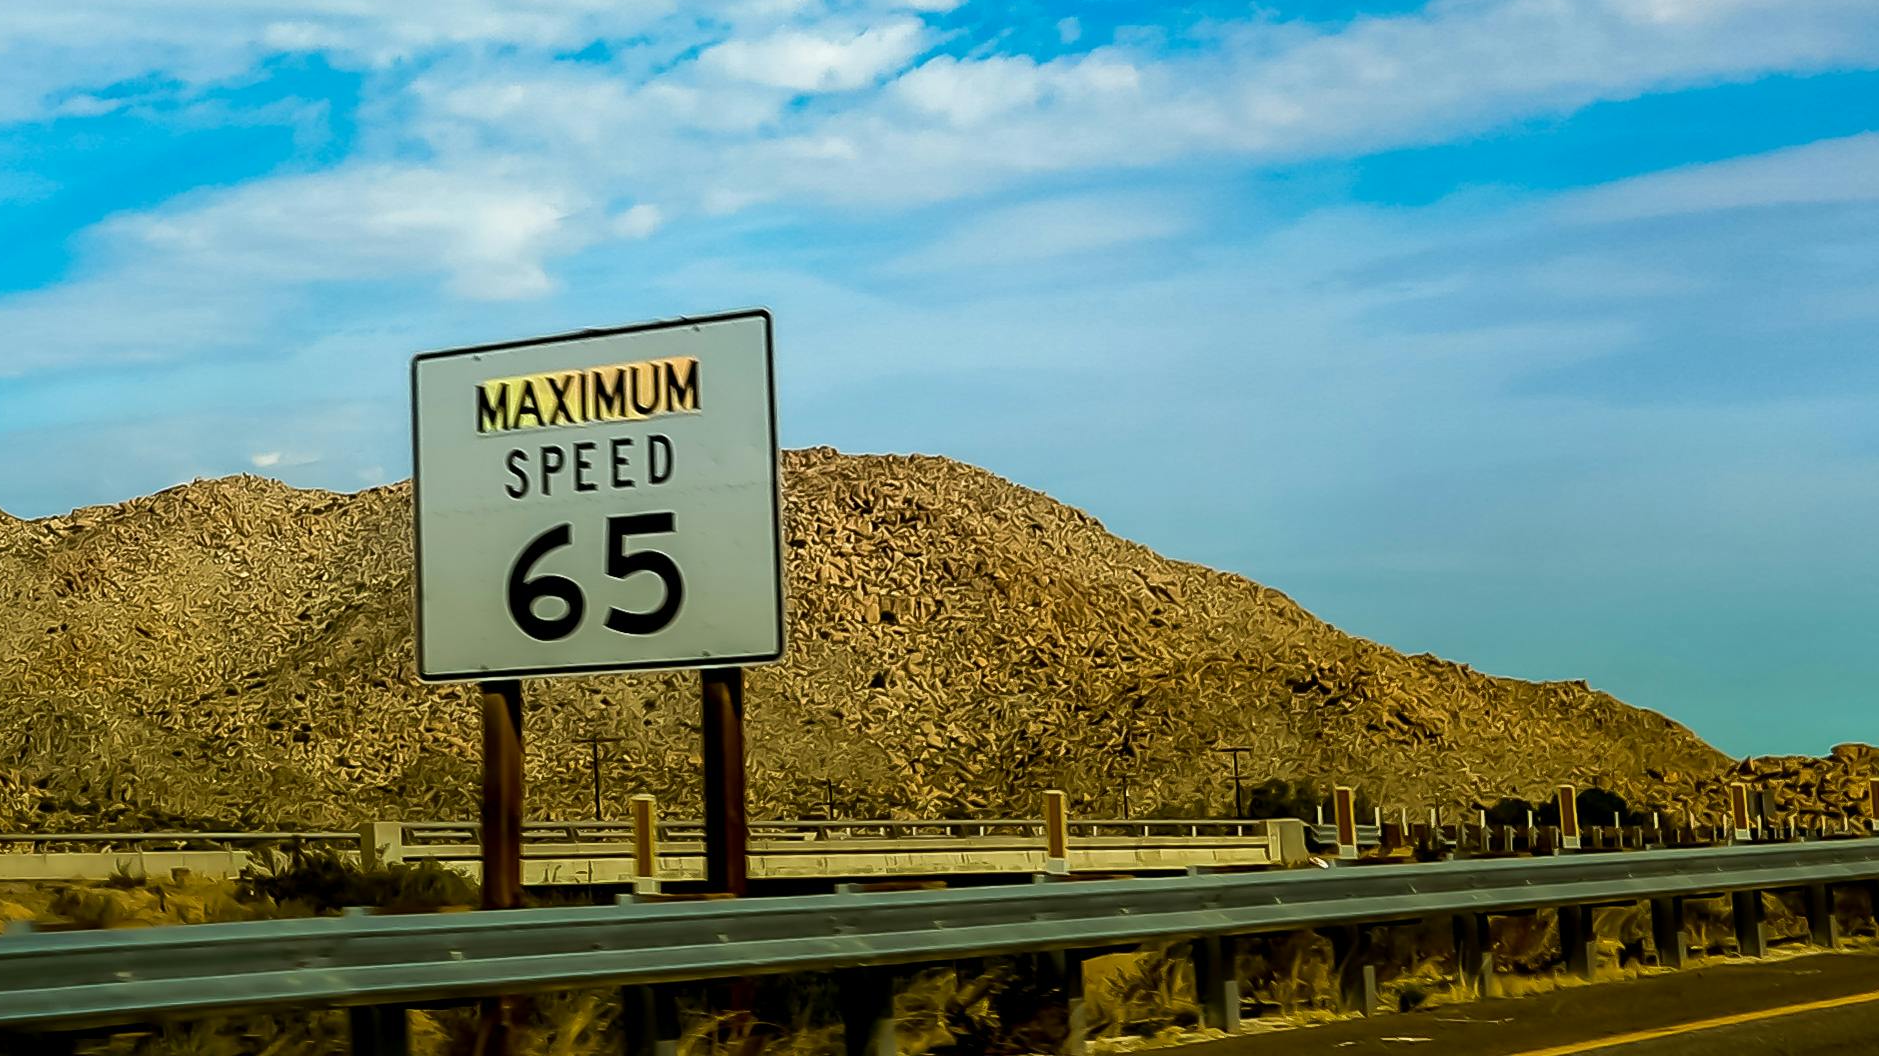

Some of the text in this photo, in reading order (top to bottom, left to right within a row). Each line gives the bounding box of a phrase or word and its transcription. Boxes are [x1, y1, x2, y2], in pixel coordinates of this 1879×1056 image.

[475, 358, 701, 433] MAXIMUM
[505, 434, 675, 499] SPEED
[507, 512, 683, 642] 65
